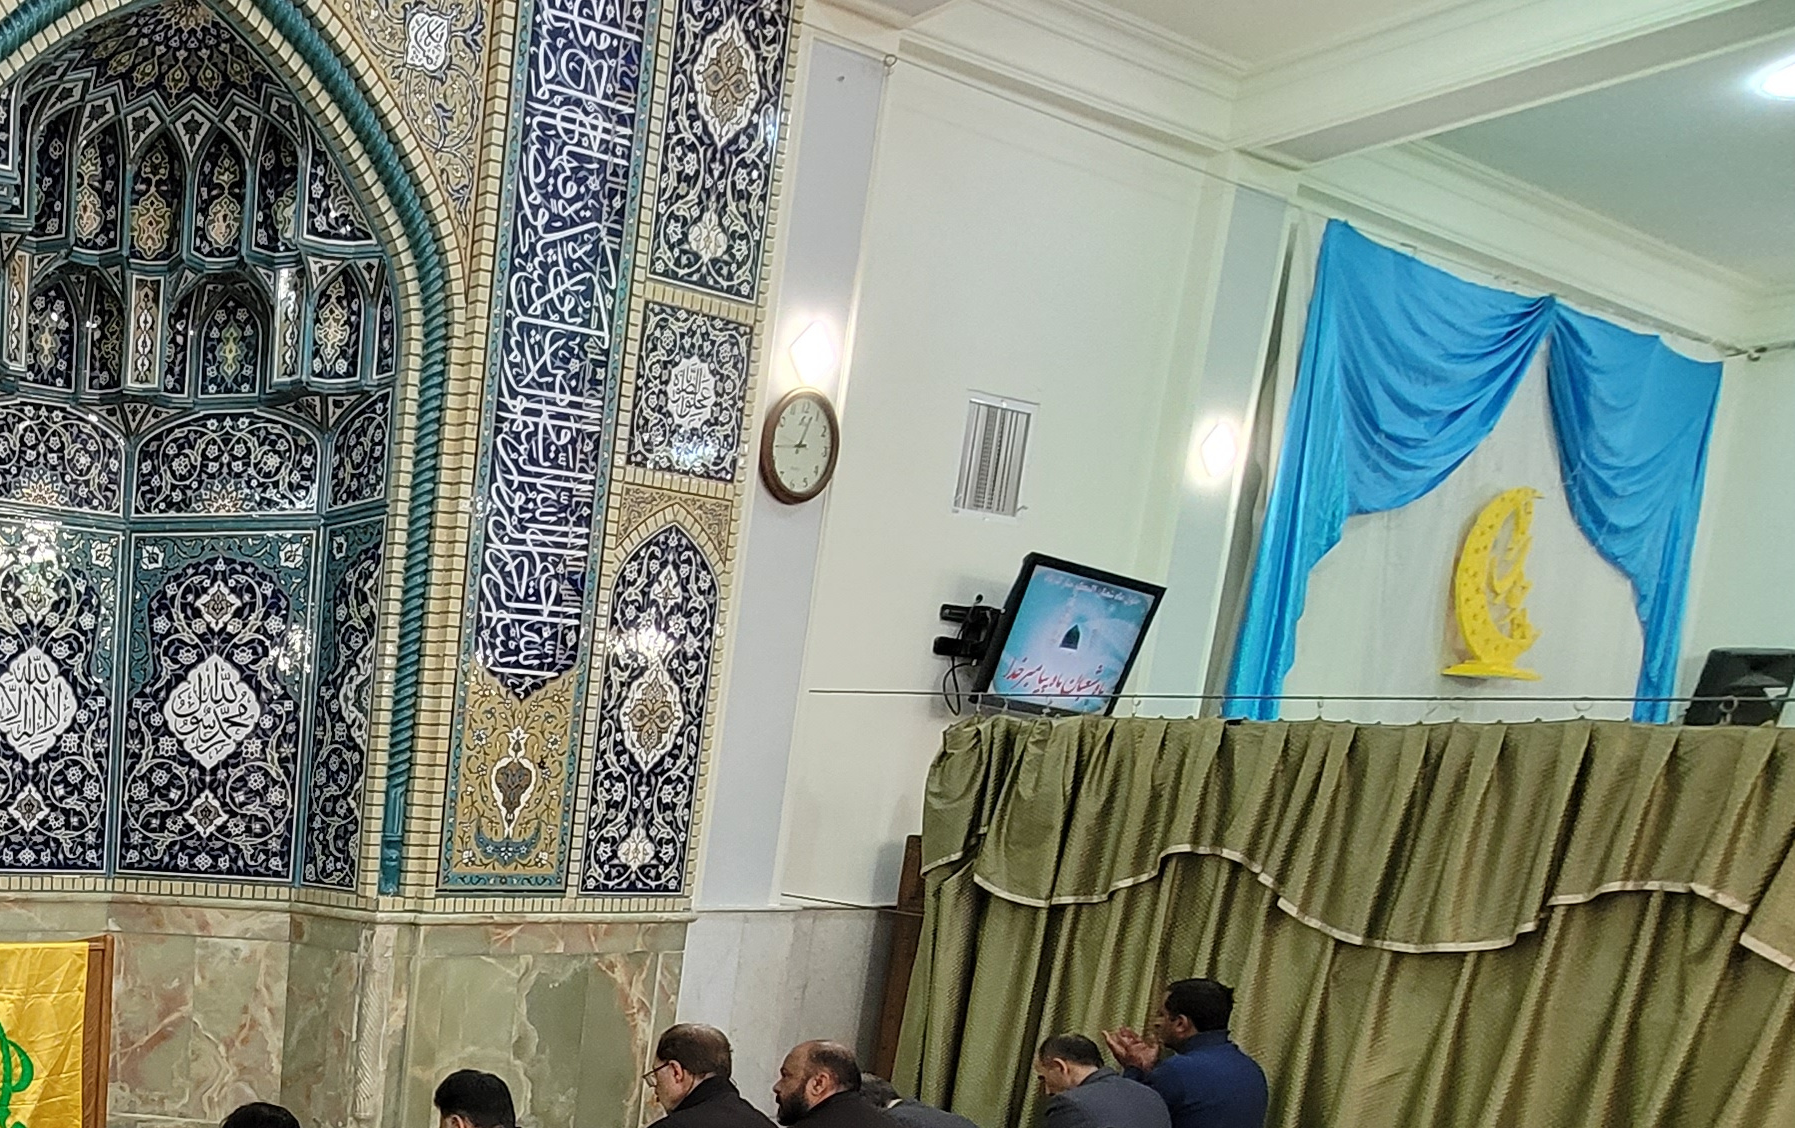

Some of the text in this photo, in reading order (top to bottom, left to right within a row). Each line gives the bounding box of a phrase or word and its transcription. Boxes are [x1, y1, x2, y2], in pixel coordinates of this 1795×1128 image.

[1003, 657, 1028, 680] خدا
[1049, 671, 1062, 688] ماه
[1060, 664, 1104, 701] شعبان
